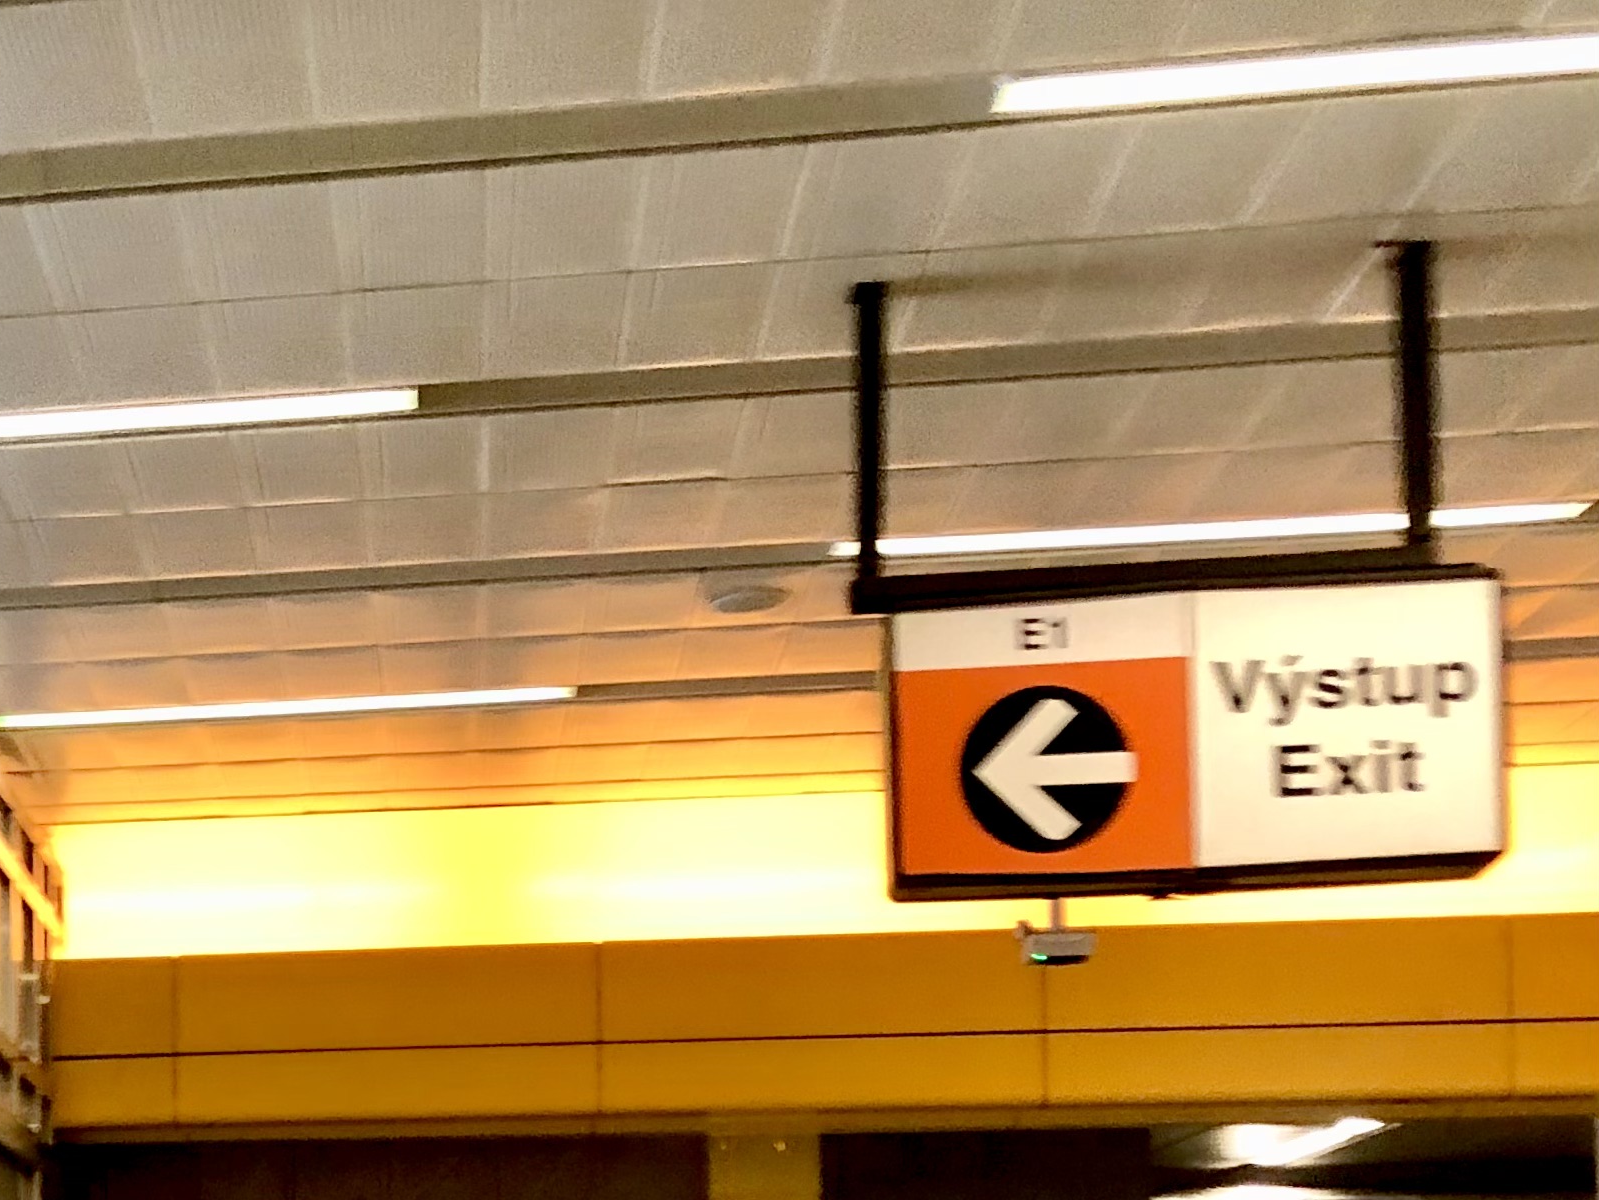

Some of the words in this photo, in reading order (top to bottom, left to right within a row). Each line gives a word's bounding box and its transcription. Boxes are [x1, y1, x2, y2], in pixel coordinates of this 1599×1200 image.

[1013, 617, 1069, 650] E1
[1209, 653, 1480, 726] Výstup
[1269, 740, 1426, 799] Exit
